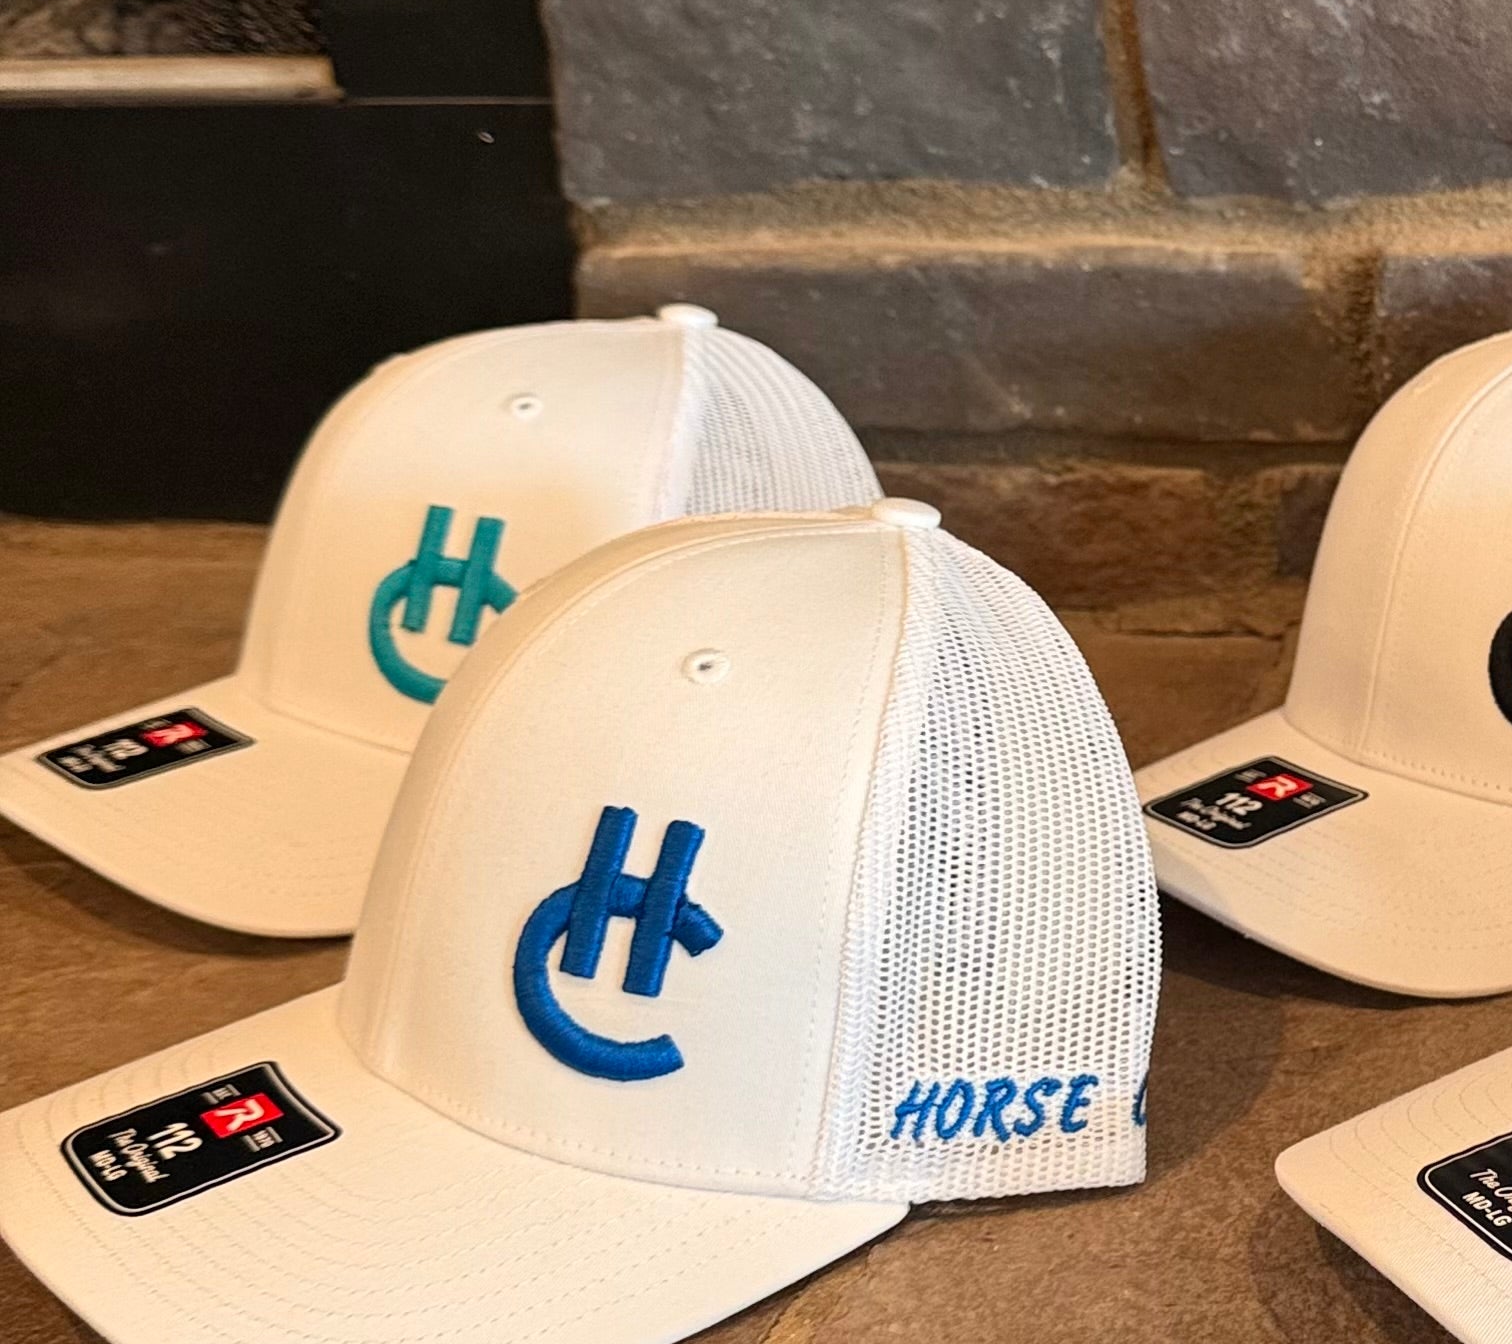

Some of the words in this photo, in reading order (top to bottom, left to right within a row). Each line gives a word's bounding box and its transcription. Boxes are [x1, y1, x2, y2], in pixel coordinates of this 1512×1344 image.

[213, 1098, 265, 1132] R
[890, 1072, 1099, 1143] HORSE
[146, 1122, 203, 1160] 112
[120, 1142, 171, 1184] Original
[1469, 1168, 1501, 1190] The
[1461, 1191, 1512, 1227] MD-LG
